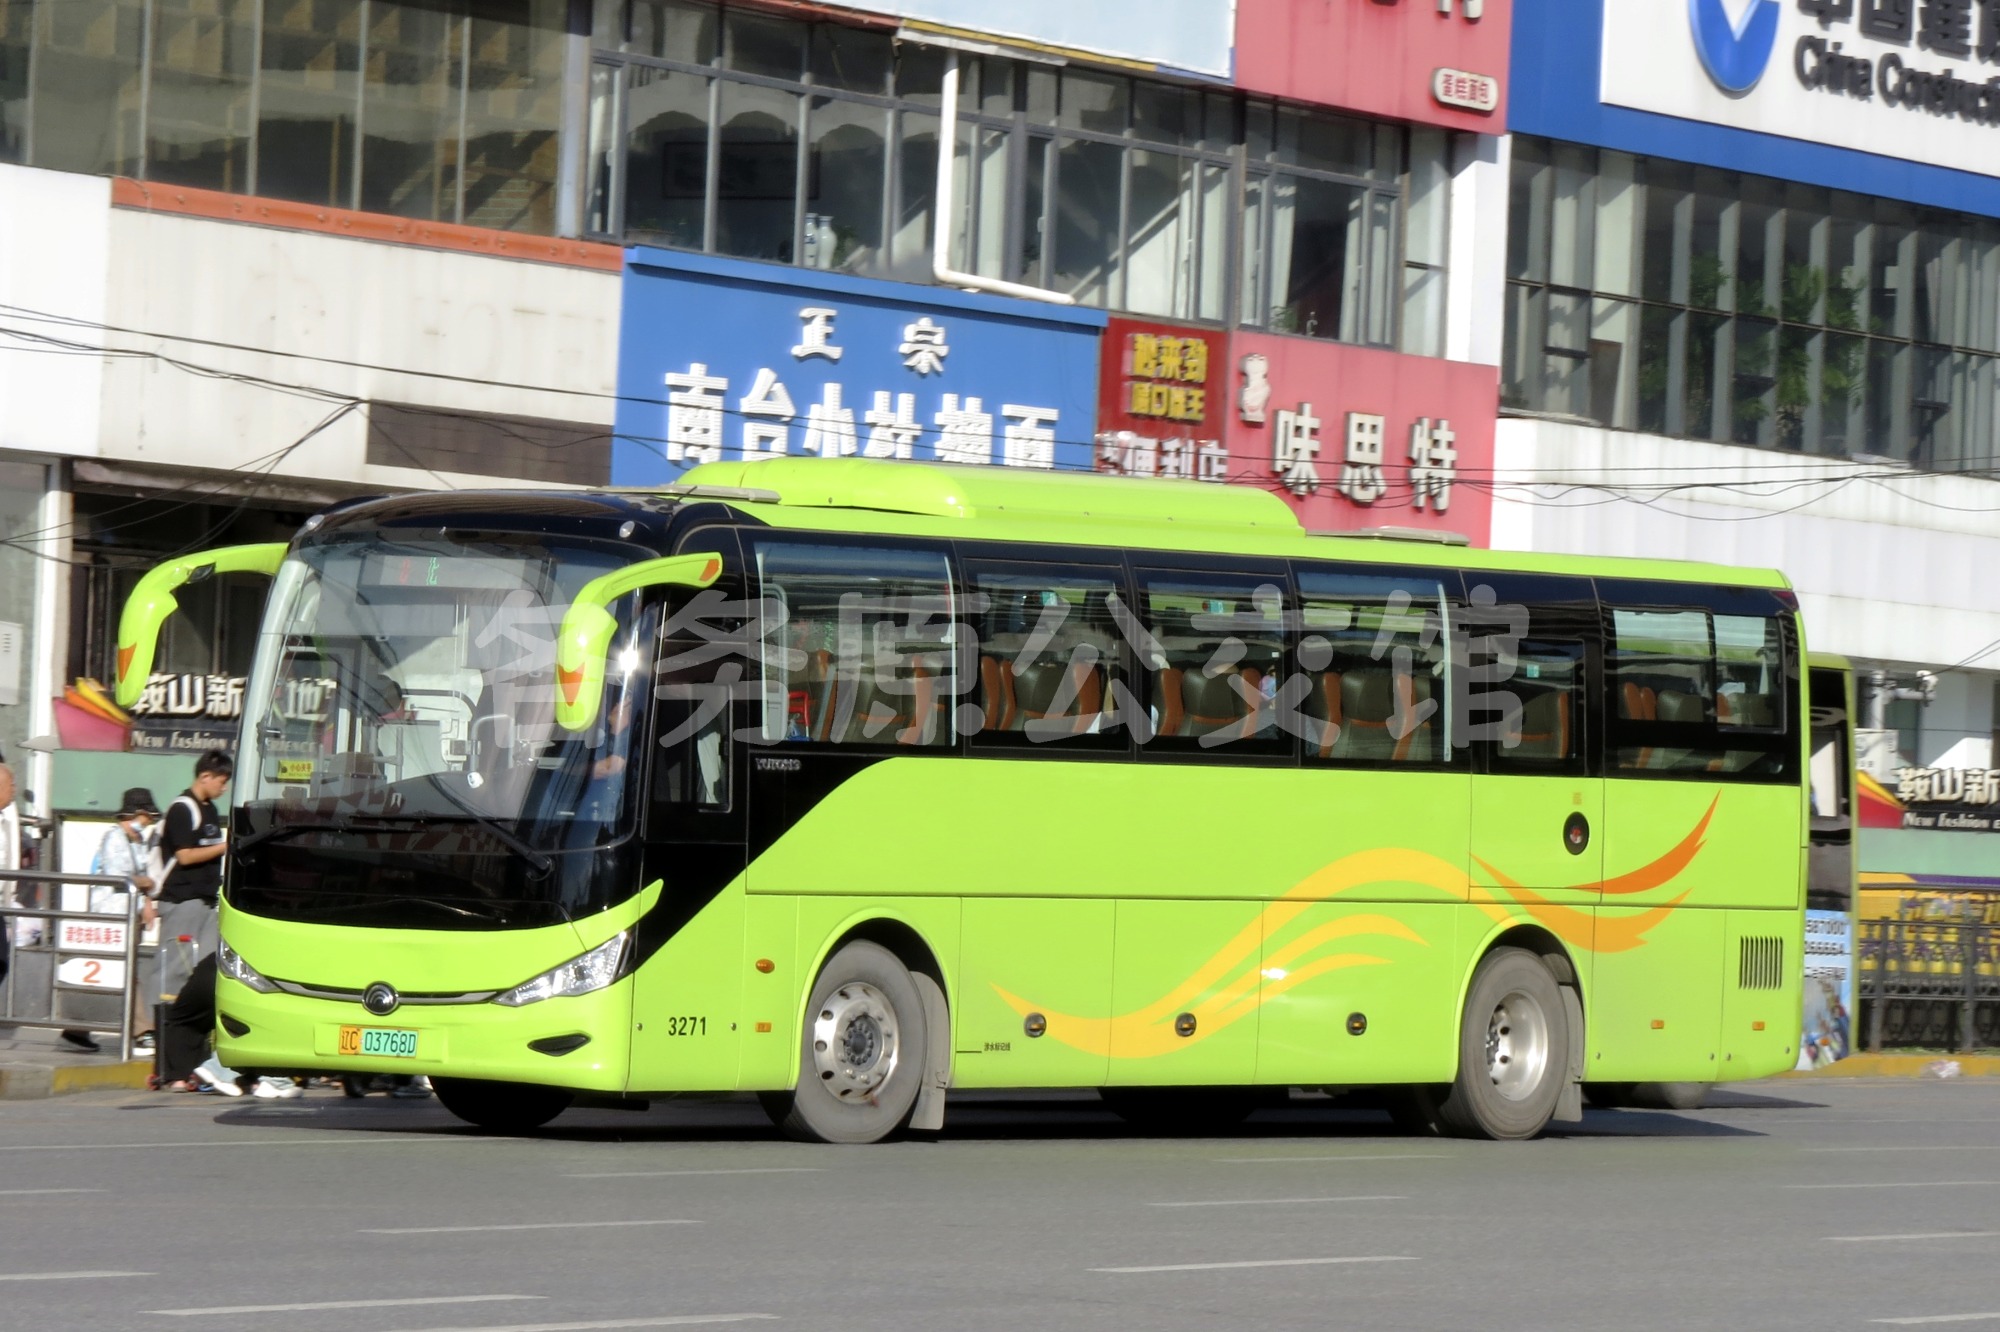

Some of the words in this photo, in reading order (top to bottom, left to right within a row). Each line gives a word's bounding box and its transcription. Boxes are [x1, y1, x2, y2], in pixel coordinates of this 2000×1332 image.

[1795, 35, 1873, 102] China
[791, 307, 949, 374] 正宗
[1273, 402, 1457, 514] 味思特
[1891, 767, 2000, 804] 鞍山新
[82, 961, 101, 983] 2
[668, 1016, 706, 1036] 3271
